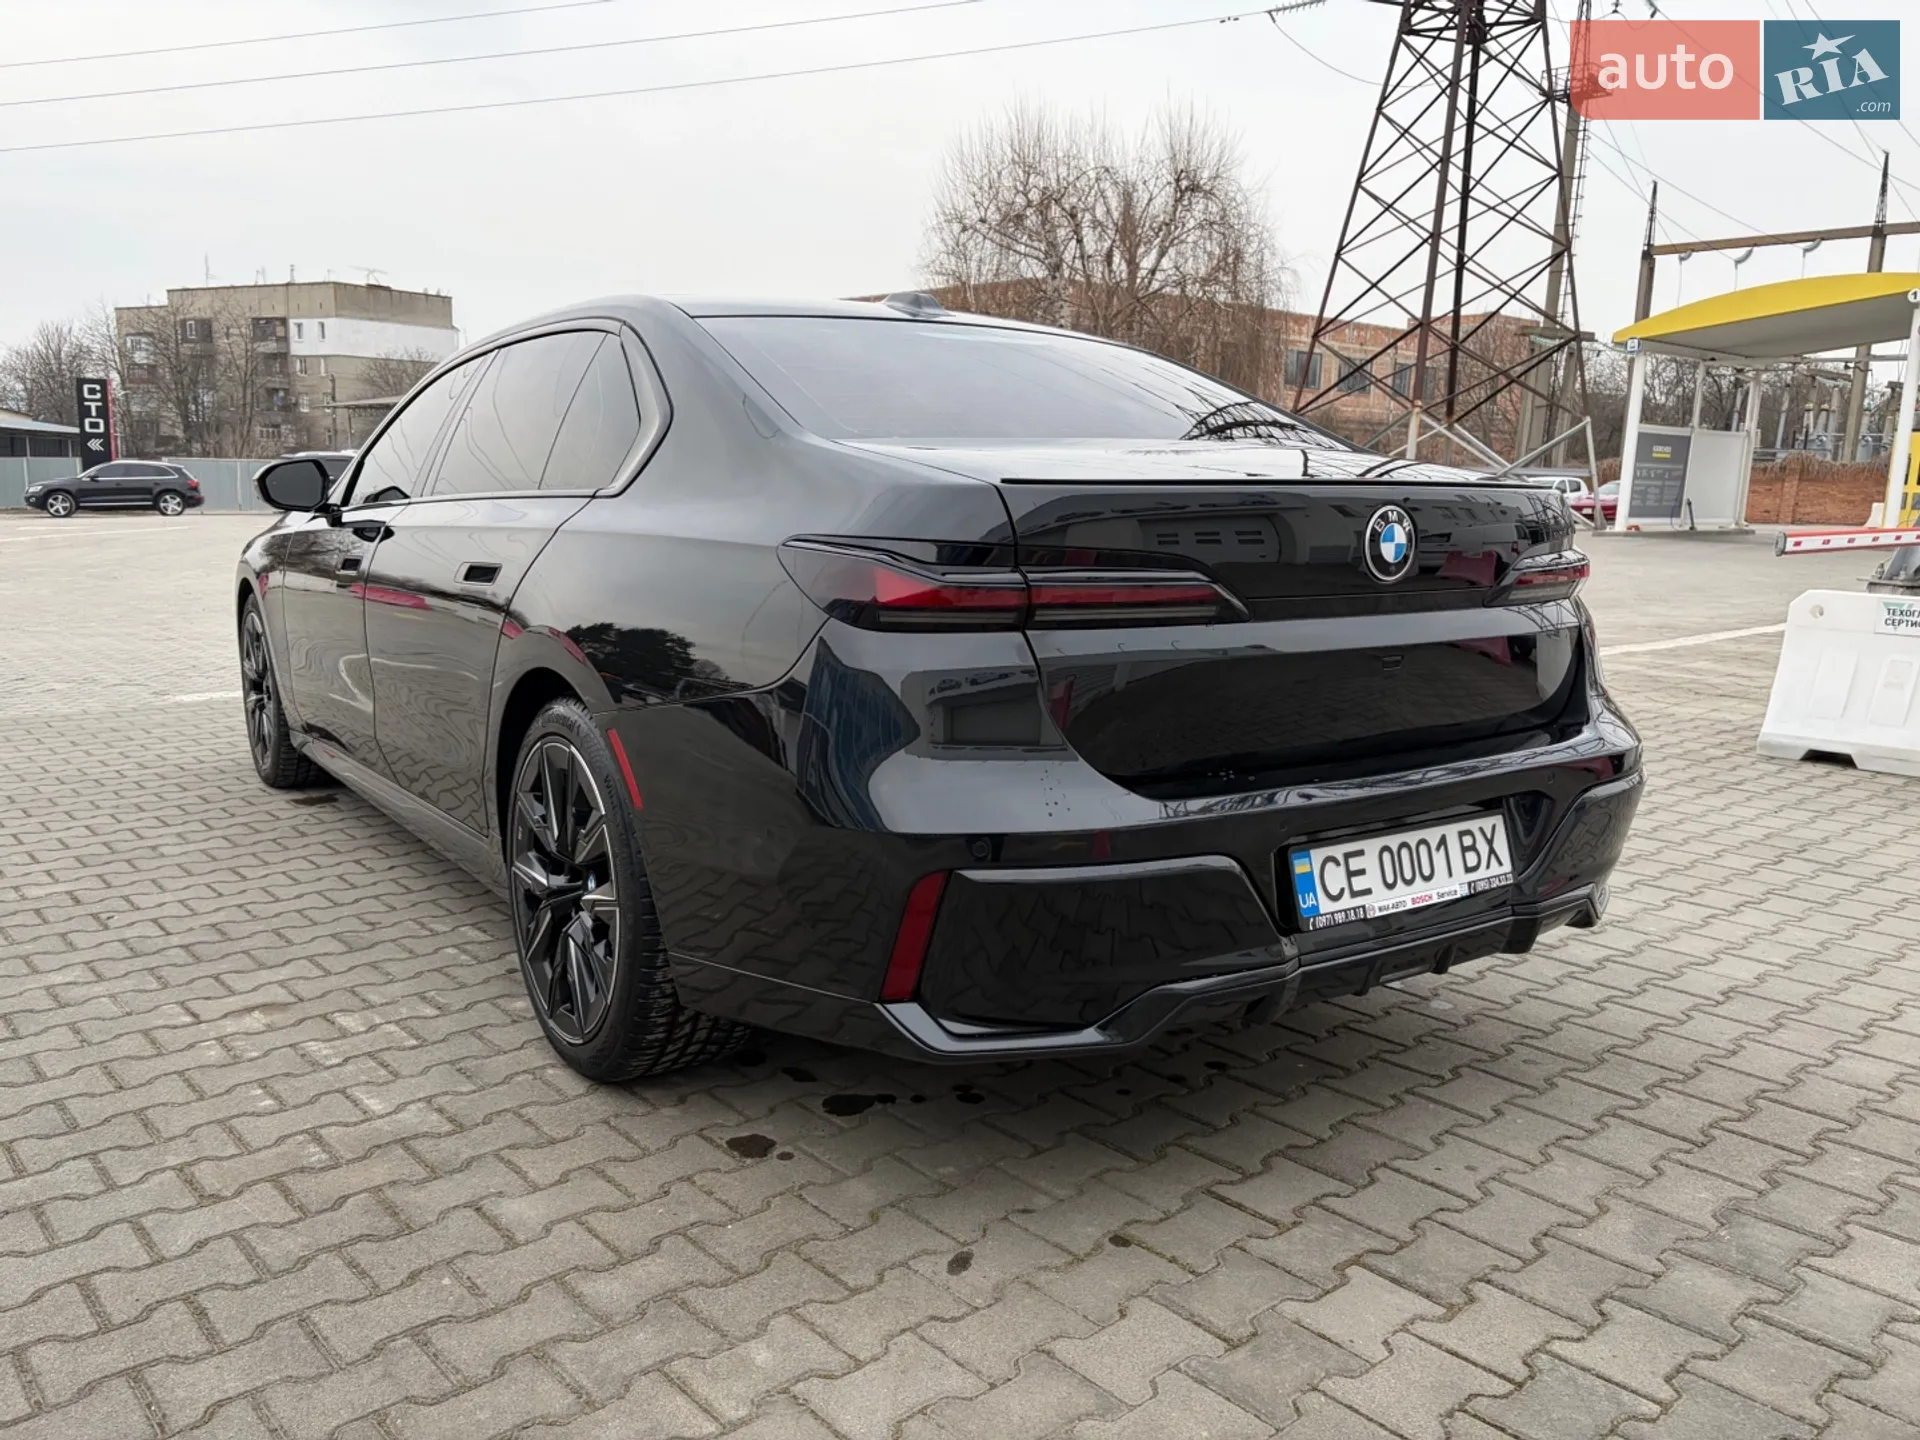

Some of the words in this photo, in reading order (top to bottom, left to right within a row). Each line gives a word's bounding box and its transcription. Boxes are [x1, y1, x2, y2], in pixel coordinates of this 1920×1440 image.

[83, 384, 105, 433] СТО
[1373, 510, 1411, 533] BMW
[1319, 848, 1374, 903] CE
[1378, 833, 1453, 891] 0001
[1457, 823, 1504, 875] BX
[1298, 892, 1318, 909] UA
[1410, 893, 1433, 906] BOSCH
[1436, 889, 1458, 900] Service
